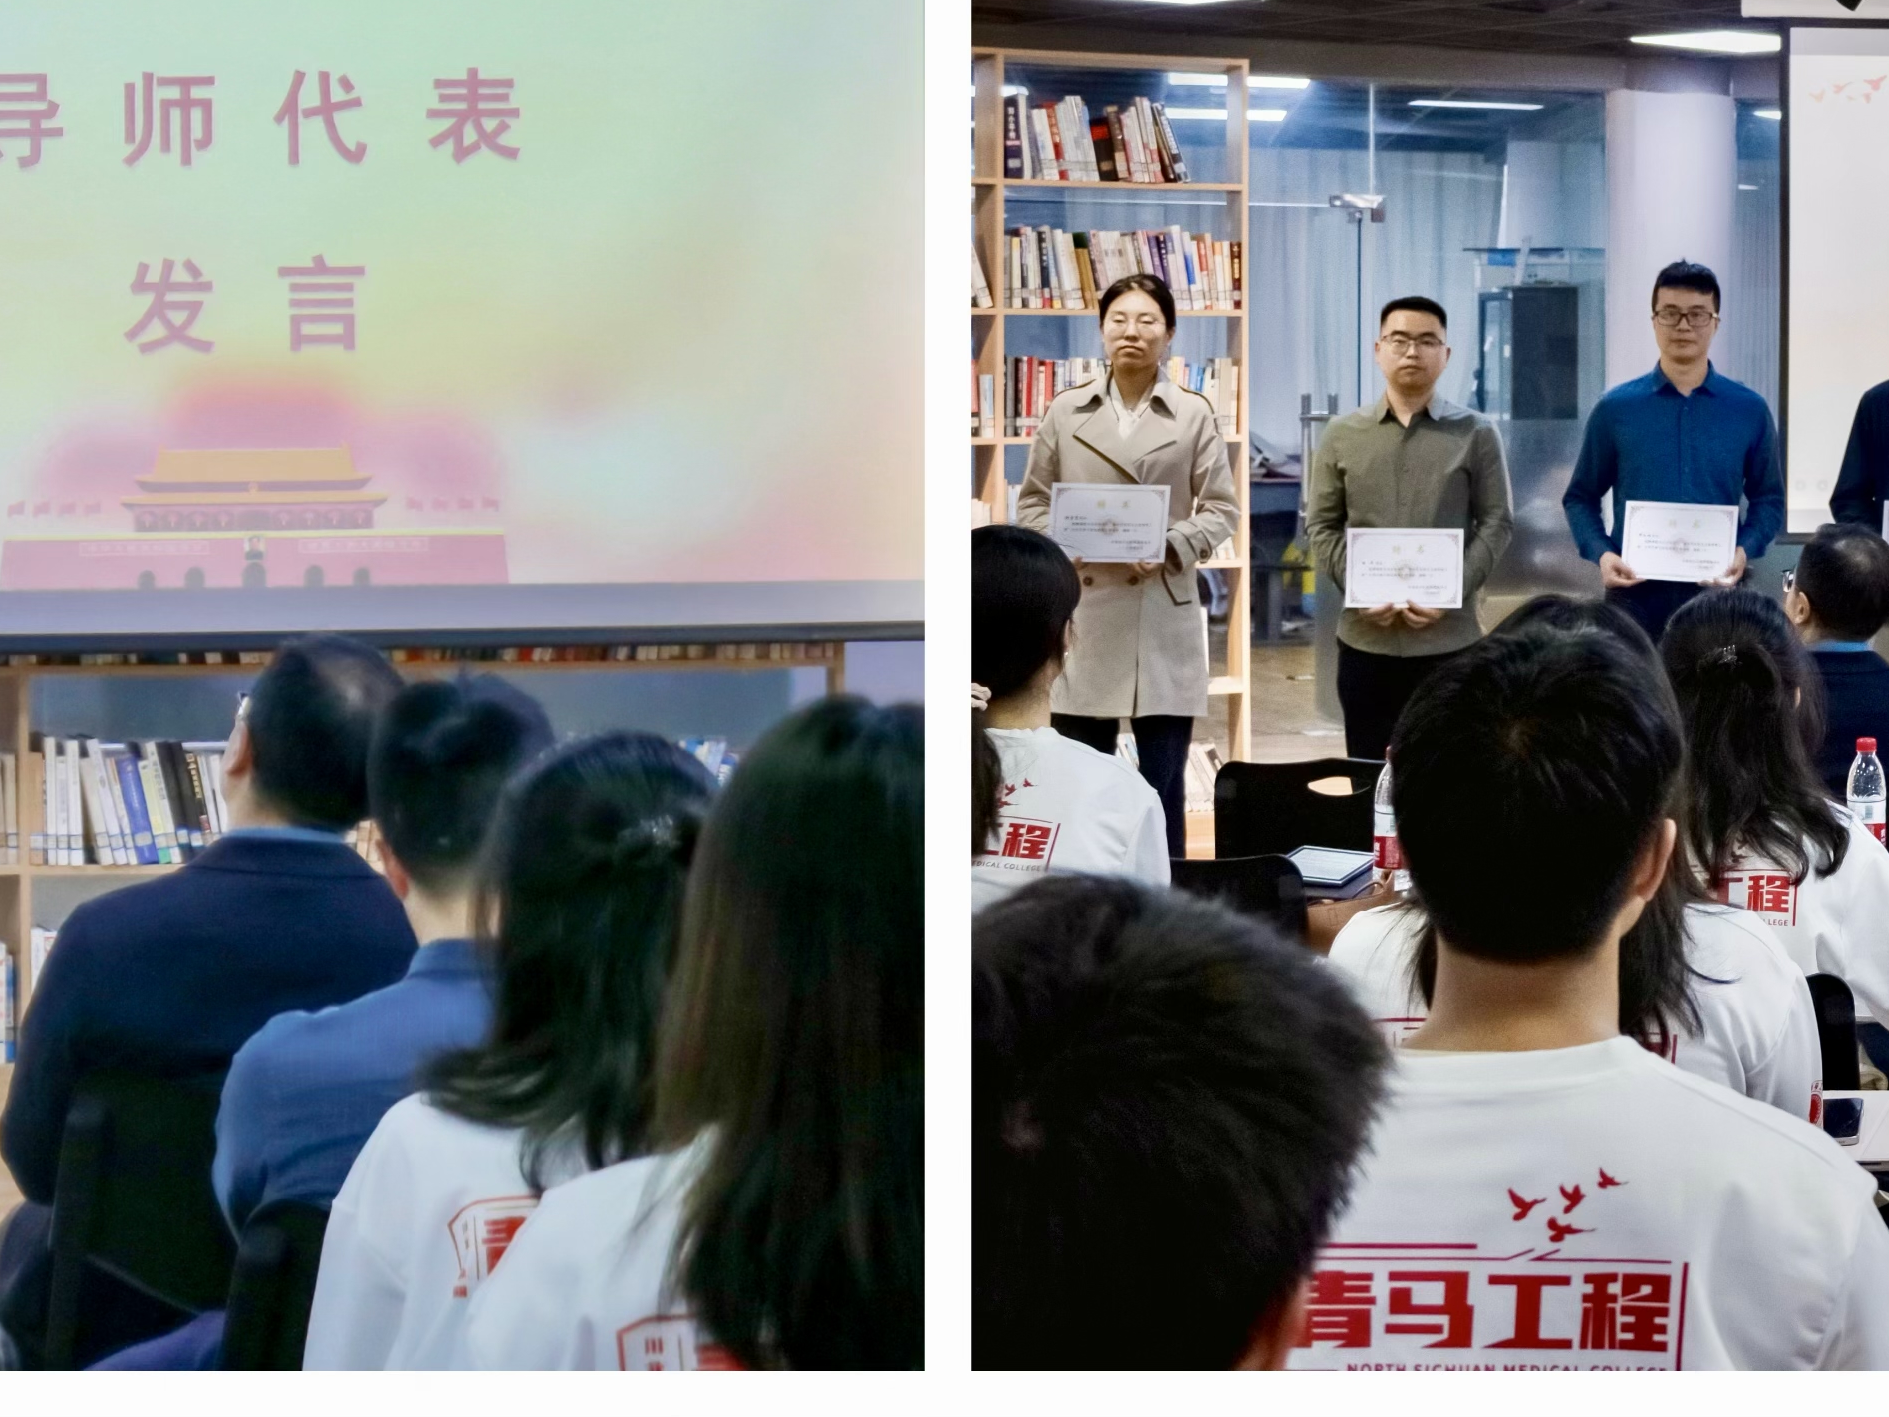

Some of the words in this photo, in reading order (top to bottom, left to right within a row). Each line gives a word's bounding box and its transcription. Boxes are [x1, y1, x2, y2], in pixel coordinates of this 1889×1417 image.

[123, 253, 366, 355] 发言
[1003, 863, 1041, 872] COLLEGE
[1304, 1270, 1672, 1353] 青马工程
